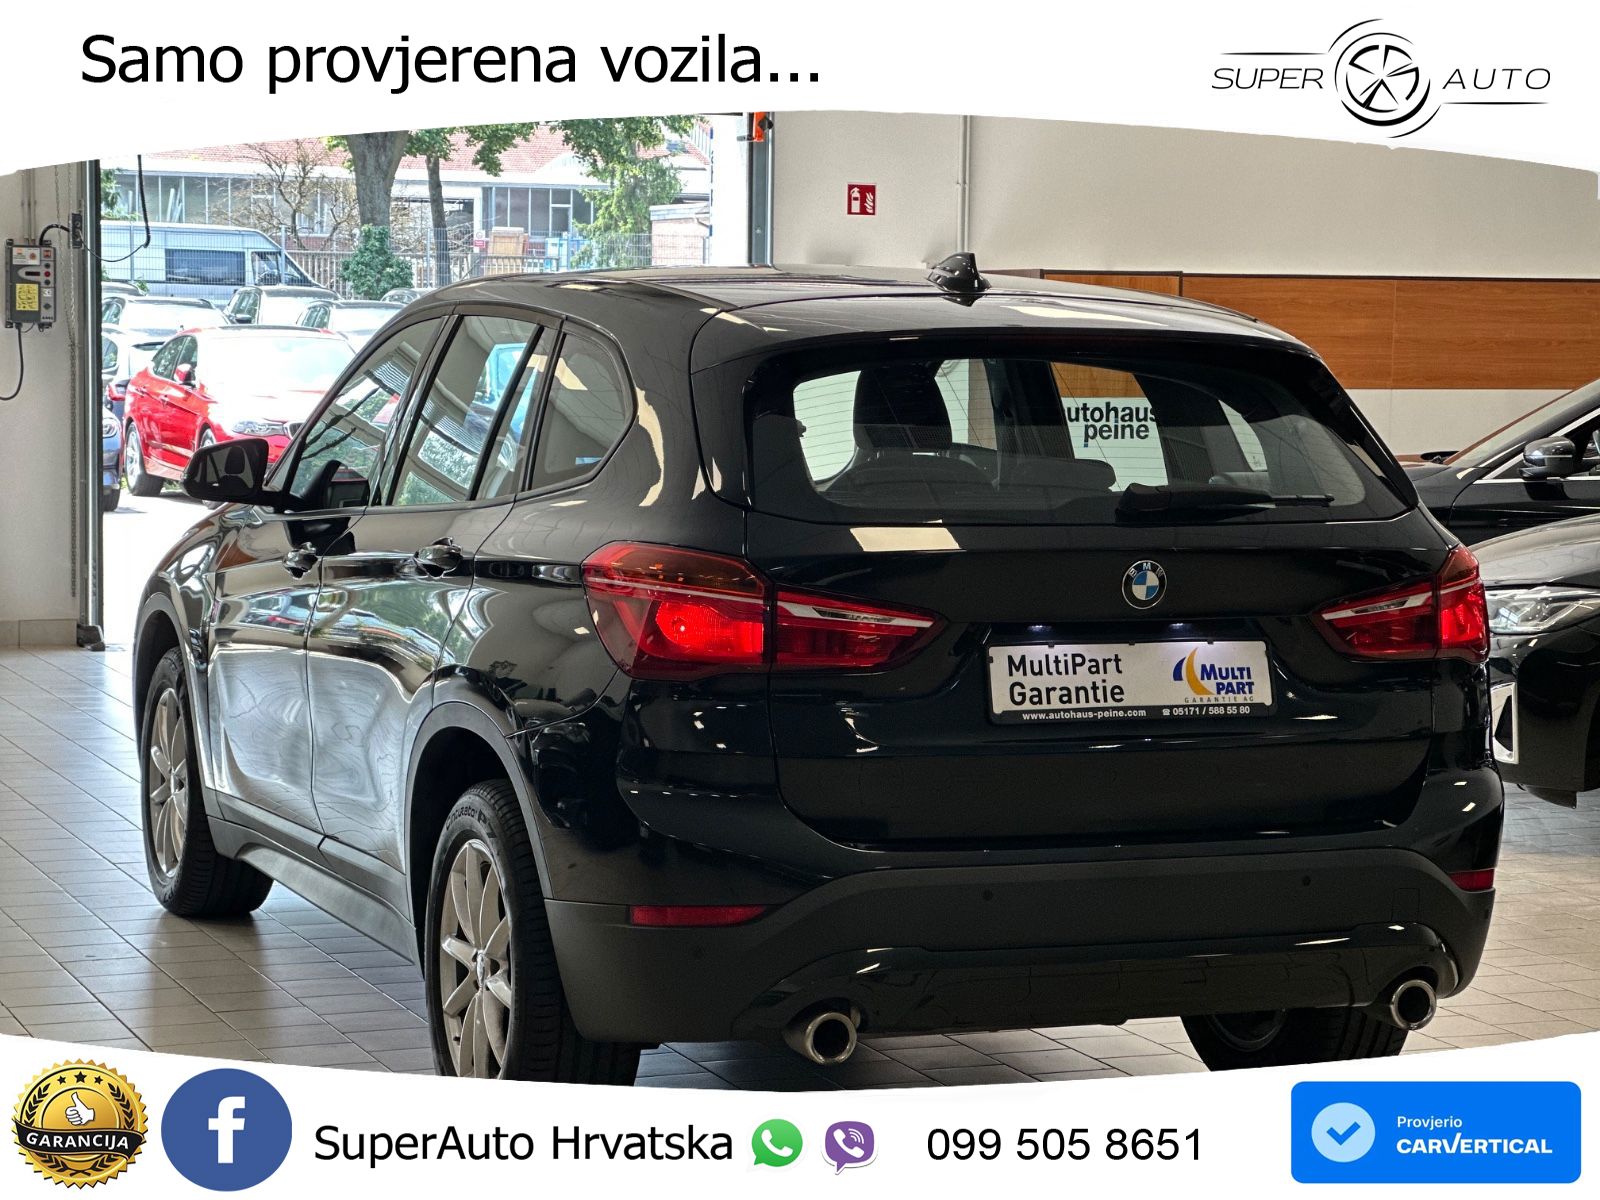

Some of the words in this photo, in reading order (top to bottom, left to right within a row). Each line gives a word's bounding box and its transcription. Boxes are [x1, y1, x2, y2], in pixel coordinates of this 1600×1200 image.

[1083, 422, 1150, 448] peine
[1007, 653, 1123, 677] MultiPart
[1009, 679, 1125, 706] Garantie
[1215, 681, 1255, 695] PART
[1184, 696, 1238, 704] GARANTIE
[1243, 695, 1254, 703] AG
[1022, 709, 1147, 720] www.autohaus-peine.com
[1172, 707, 1200, 716] 05171
[1208, 706, 1225, 715] 588
[1227, 706, 1238, 714] 55
[1239, 705, 1250, 714] 80
